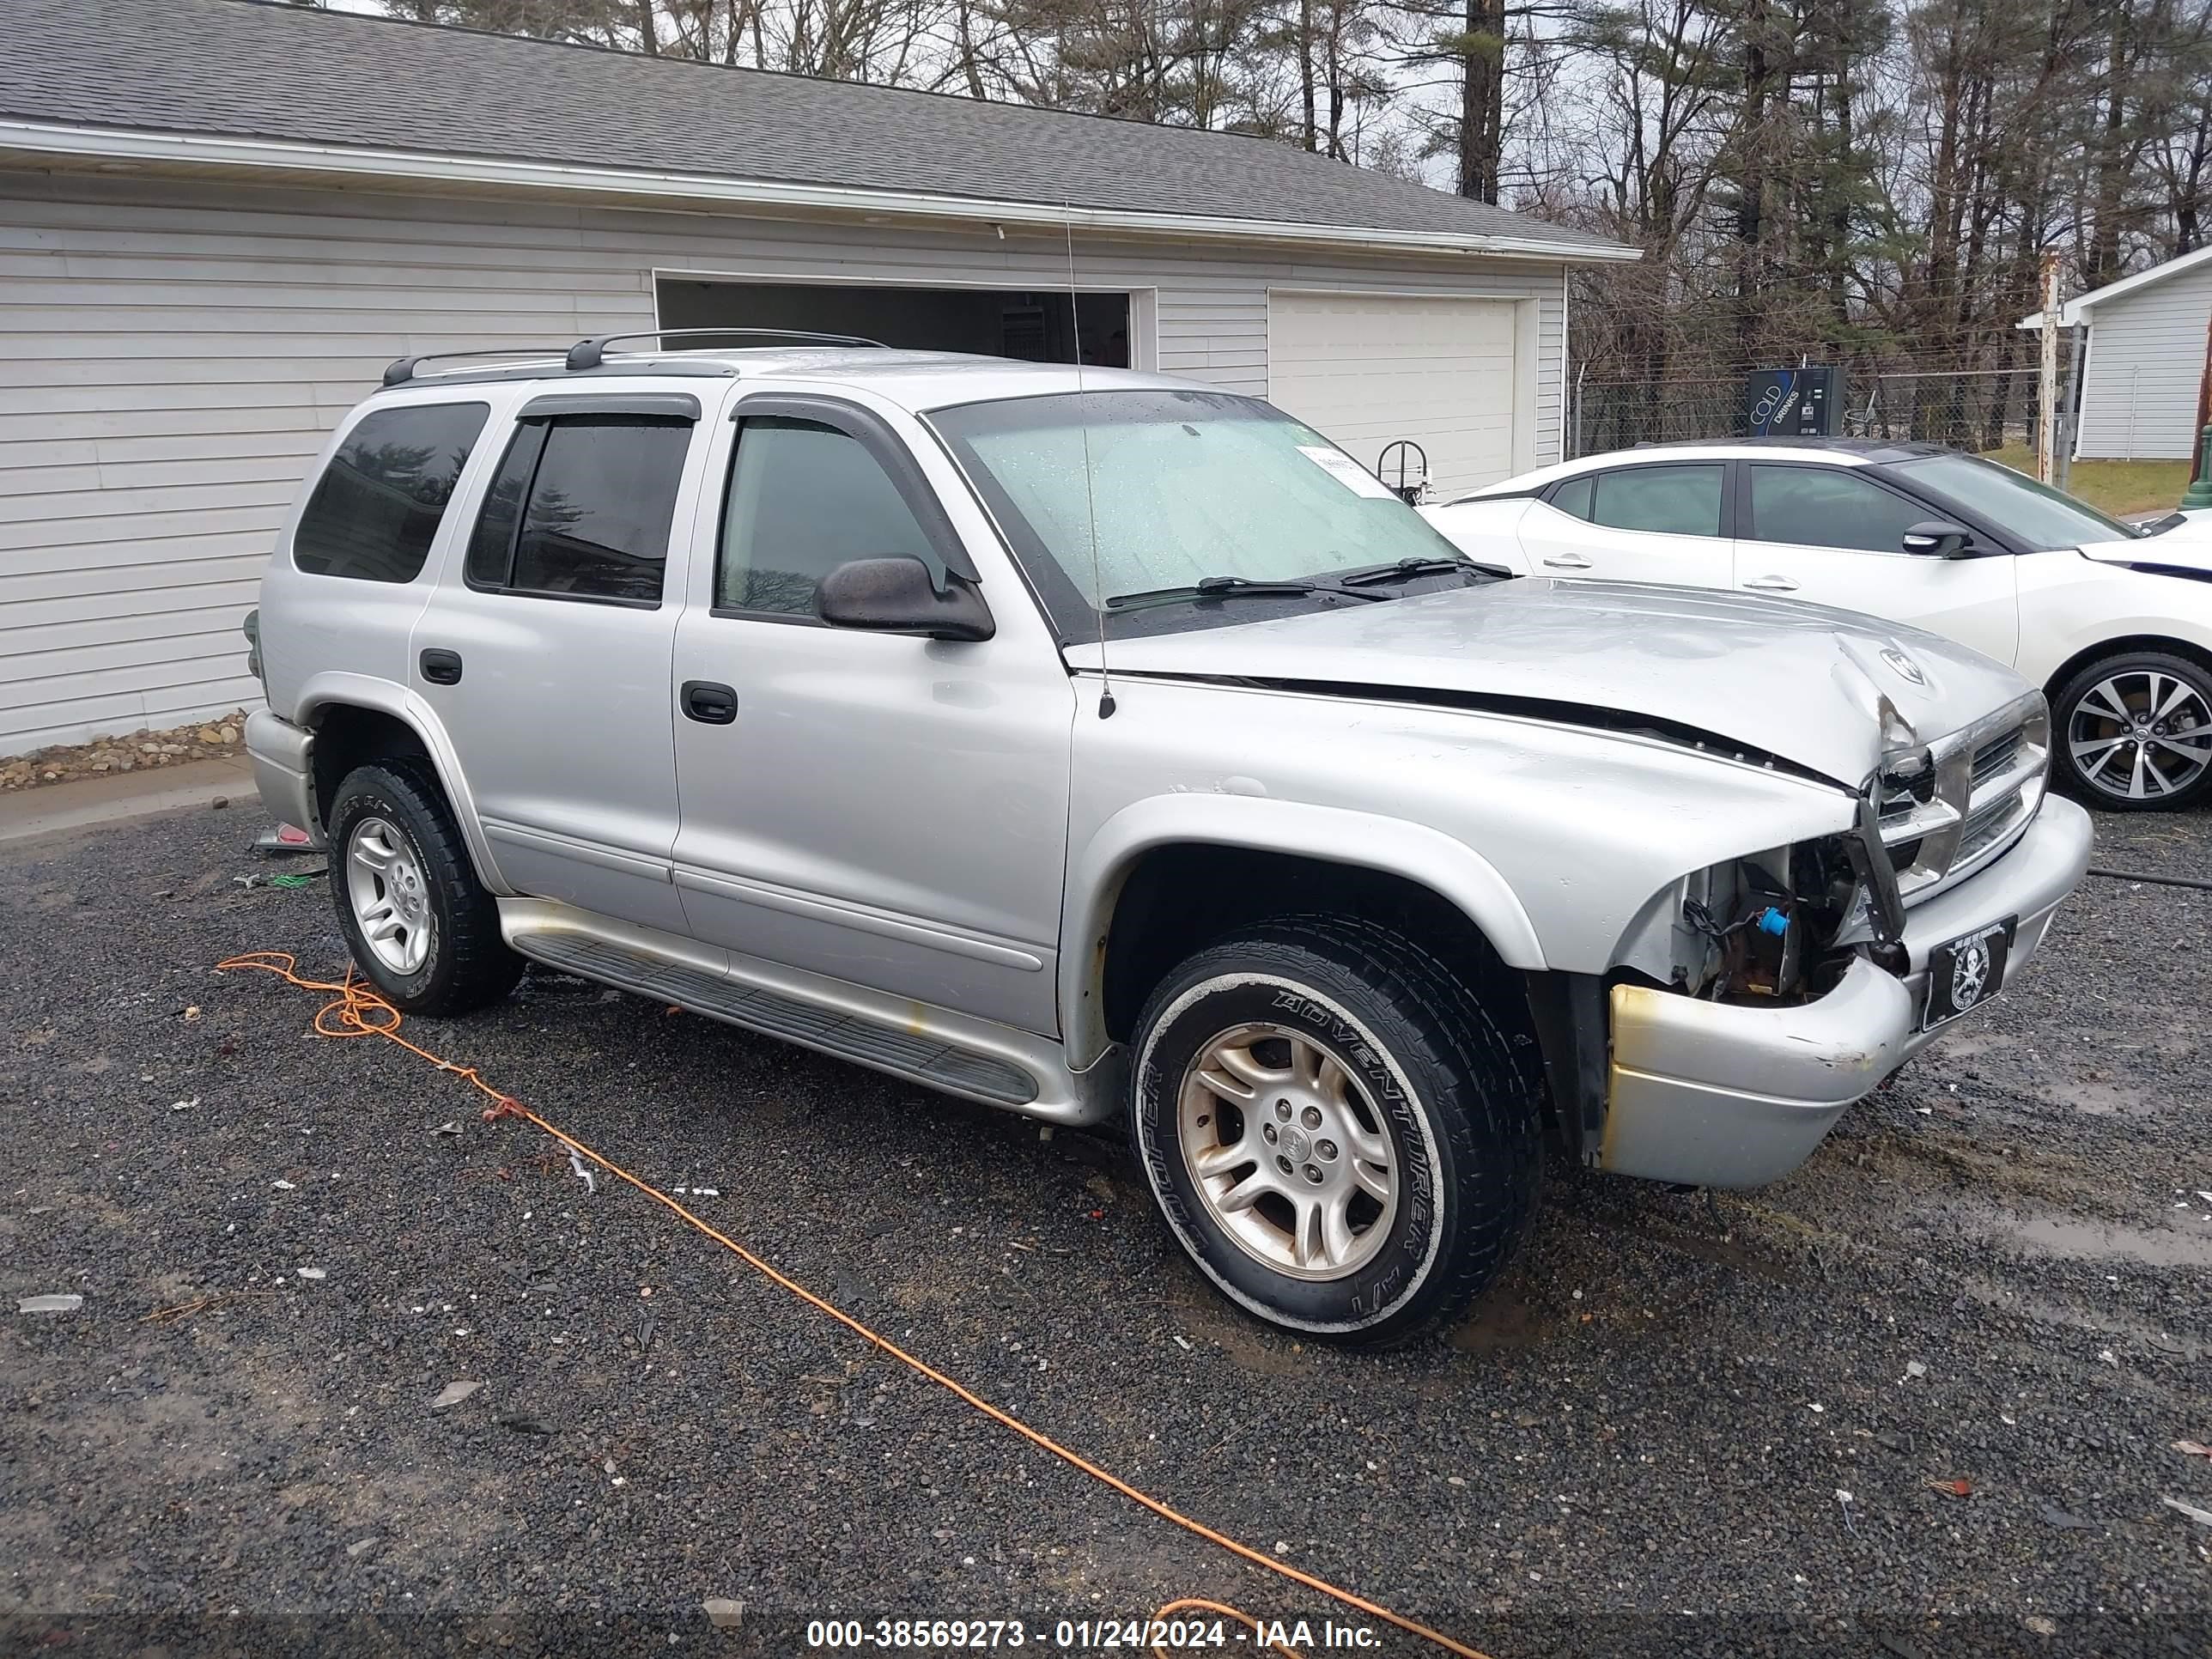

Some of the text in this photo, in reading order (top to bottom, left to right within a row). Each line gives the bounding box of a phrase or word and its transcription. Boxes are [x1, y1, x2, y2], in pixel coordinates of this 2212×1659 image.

[1750, 386, 1800, 425] COLD DRINKS
[1139, 1061, 1210, 1253] COOPER
[1271, 990, 1435, 1261] ADVENTURER
